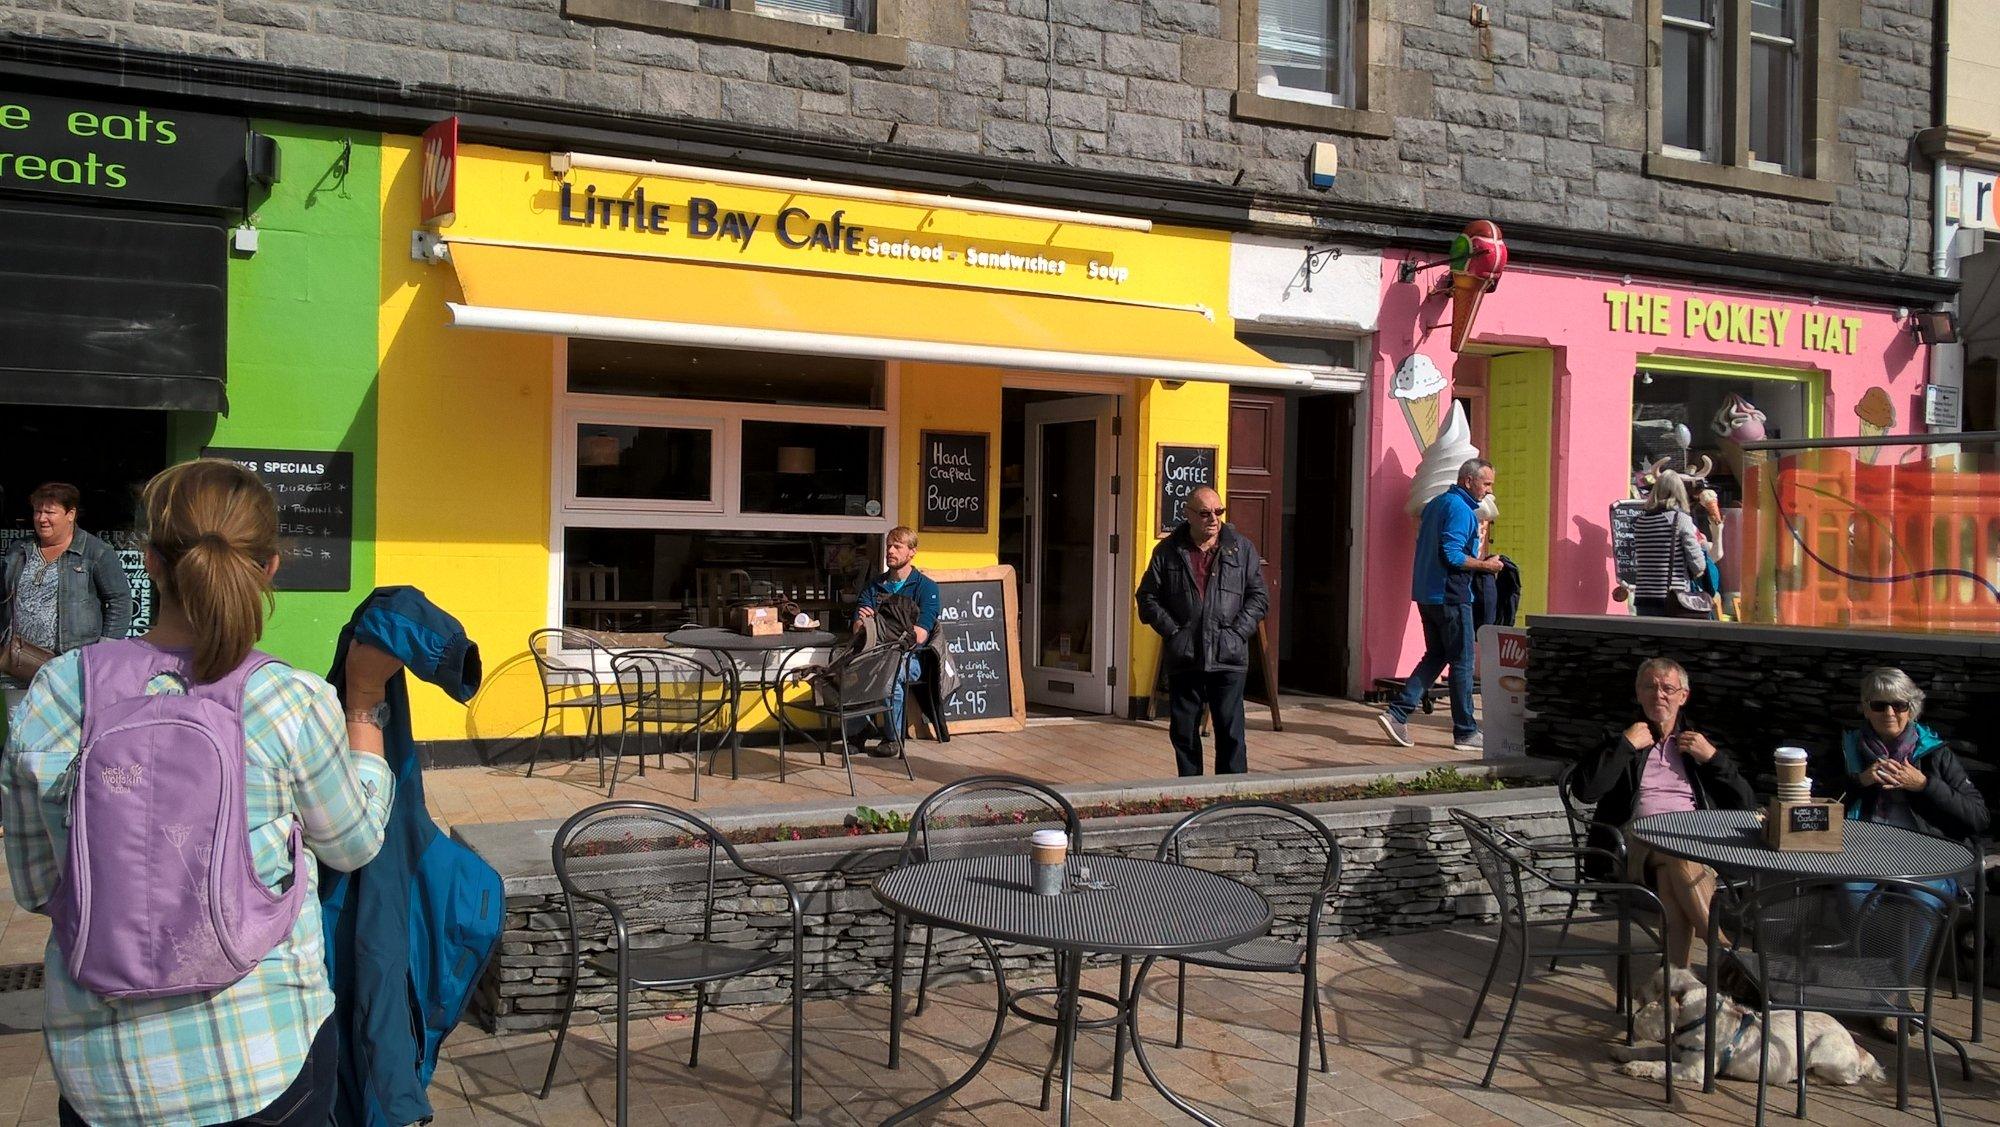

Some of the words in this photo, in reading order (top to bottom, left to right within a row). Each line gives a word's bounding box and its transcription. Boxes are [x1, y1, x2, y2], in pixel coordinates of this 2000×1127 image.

[67, 109, 177, 145] eats
[867, 236, 944, 262] Seafood
[966, 247, 1066, 275] Sandwiches
[1087, 260, 1129, 283] Soup
[1606, 290, 1672, 335] THE
[1685, 297, 1792, 347] POKEY
[1804, 311, 1863, 355] HAT
[933, 441, 972, 466] Hand
[264, 462, 325, 475] SPECIALS
[929, 466, 976, 483] Crafted
[1175, 484, 1195, 497] CA
[927, 484, 979, 522] Burgers
[279, 522, 315, 535] FLES
[938, 607, 959, 620] AB
[971, 590, 995, 619] Go
[966, 630, 1000, 652] Lunch
[1501, 639, 1526, 665] illy
[964, 660, 990, 670] drink
[976, 669, 999, 683] fruit
[944, 691, 987, 716] 4.95
[101, 774, 142, 785] Wolfskin
[102, 765, 124, 775] Jack
